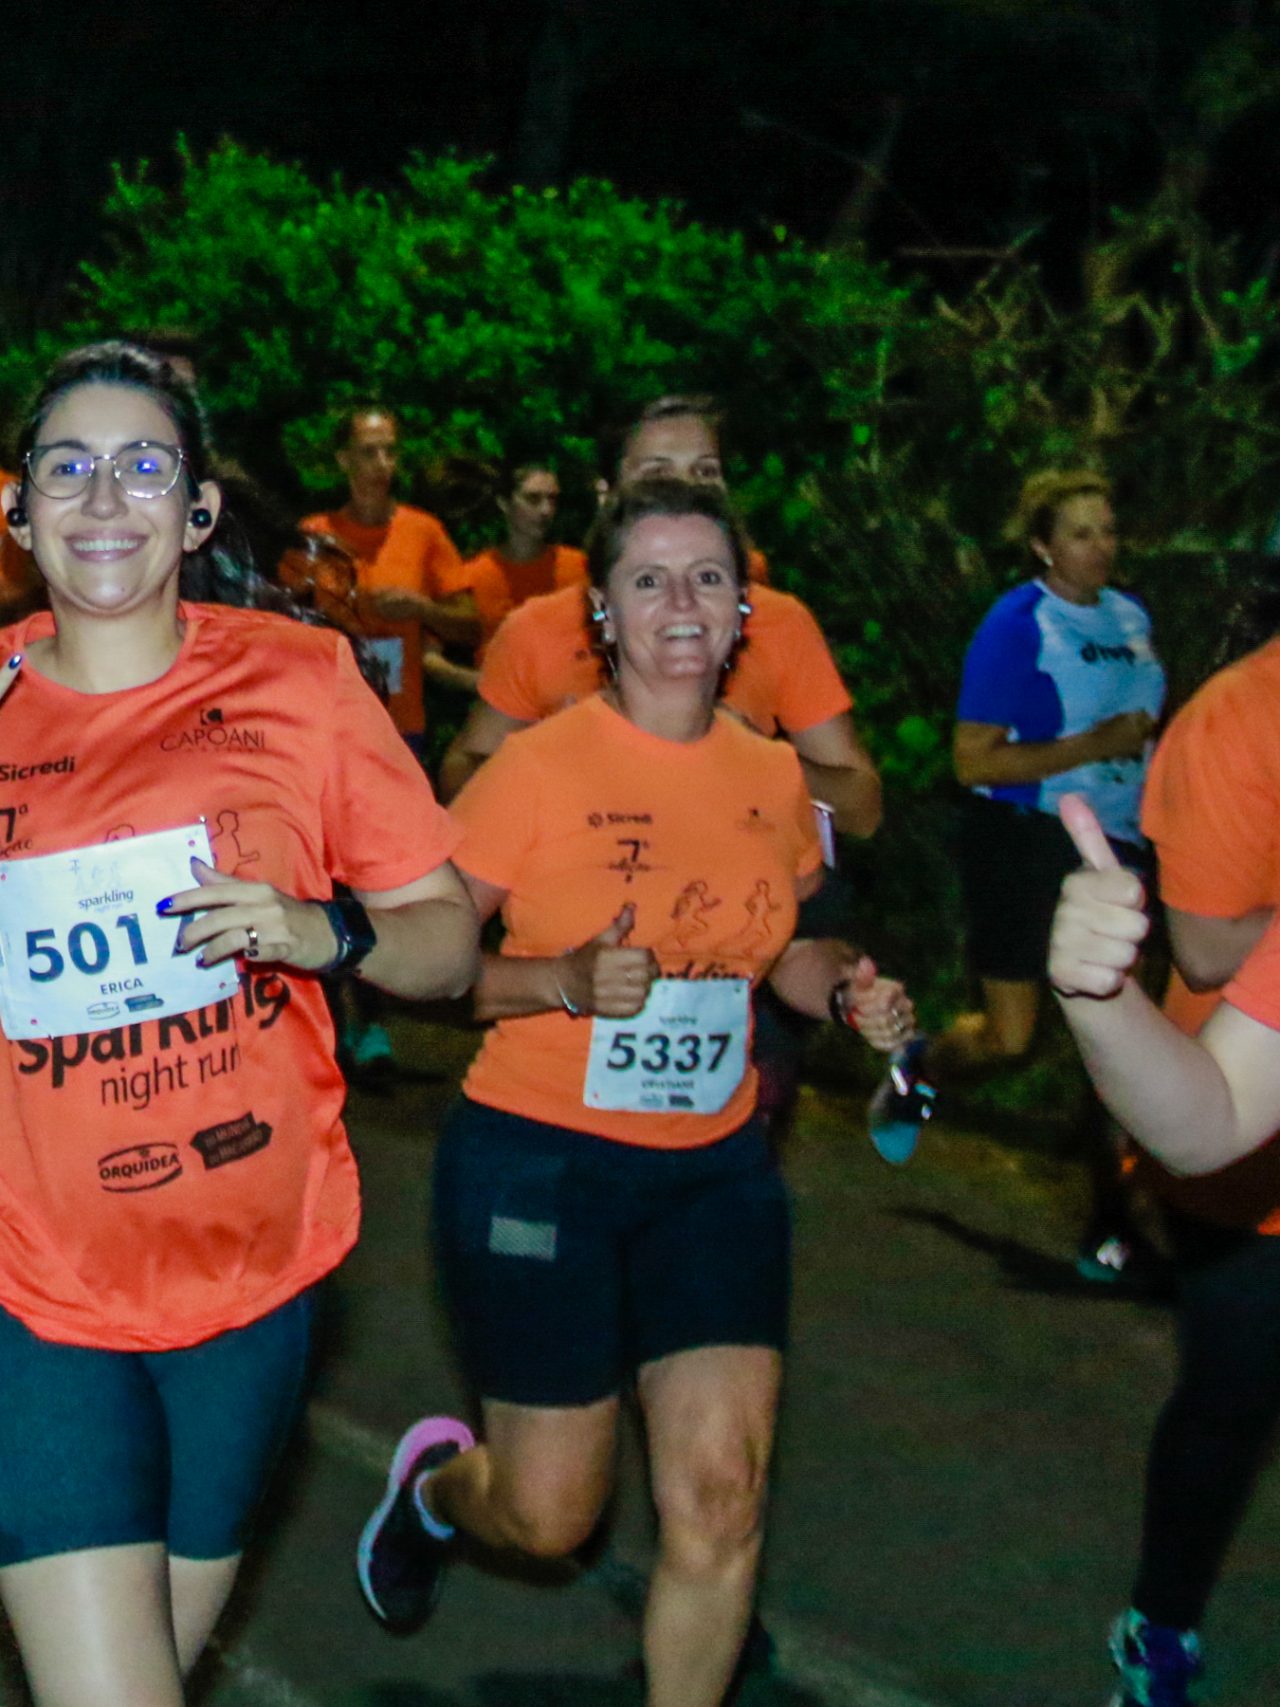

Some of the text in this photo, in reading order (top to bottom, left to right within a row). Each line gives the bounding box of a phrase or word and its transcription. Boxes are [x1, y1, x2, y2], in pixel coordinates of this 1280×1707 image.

[160, 728, 266, 752] CAPOANI
[78, 889, 134, 910] sparkling
[99, 977, 144, 996] ERICA
[606, 1032, 732, 1074] 5337
[100, 1053, 190, 1111] night
[99, 1153, 181, 1181] ORQUIDEA
